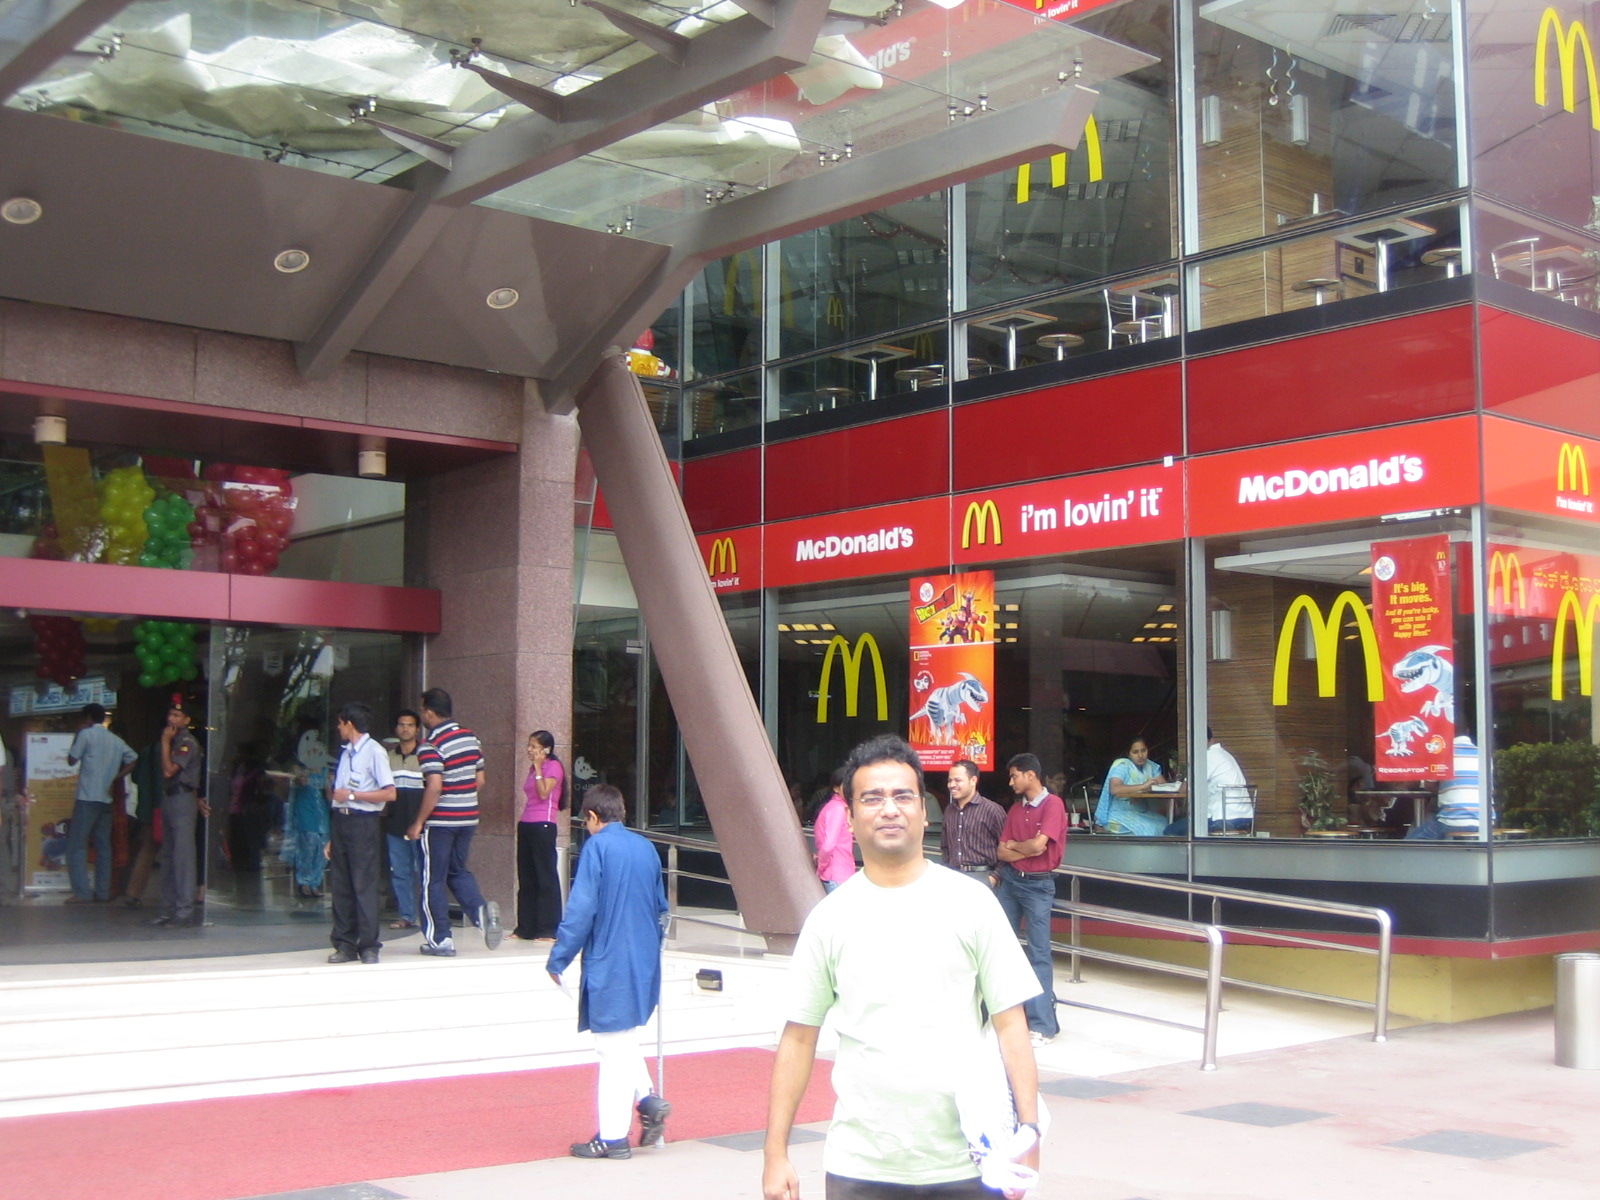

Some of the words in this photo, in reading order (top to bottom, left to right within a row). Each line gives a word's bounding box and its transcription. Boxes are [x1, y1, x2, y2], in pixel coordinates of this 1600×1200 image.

[1048, 2, 1070, 18] lovin'
[1238, 454, 1423, 504] McDonald's
[1020, 505, 1057, 533] i'm
[1064, 490, 1135, 527] lovin'
[795, 526, 914, 561] McDonald's
[1389, 594, 1398, 605] It
[1399, 593, 1433, 605] moves.
[1393, 582, 1409, 594] It's
[1411, 581, 1429, 594] big.
